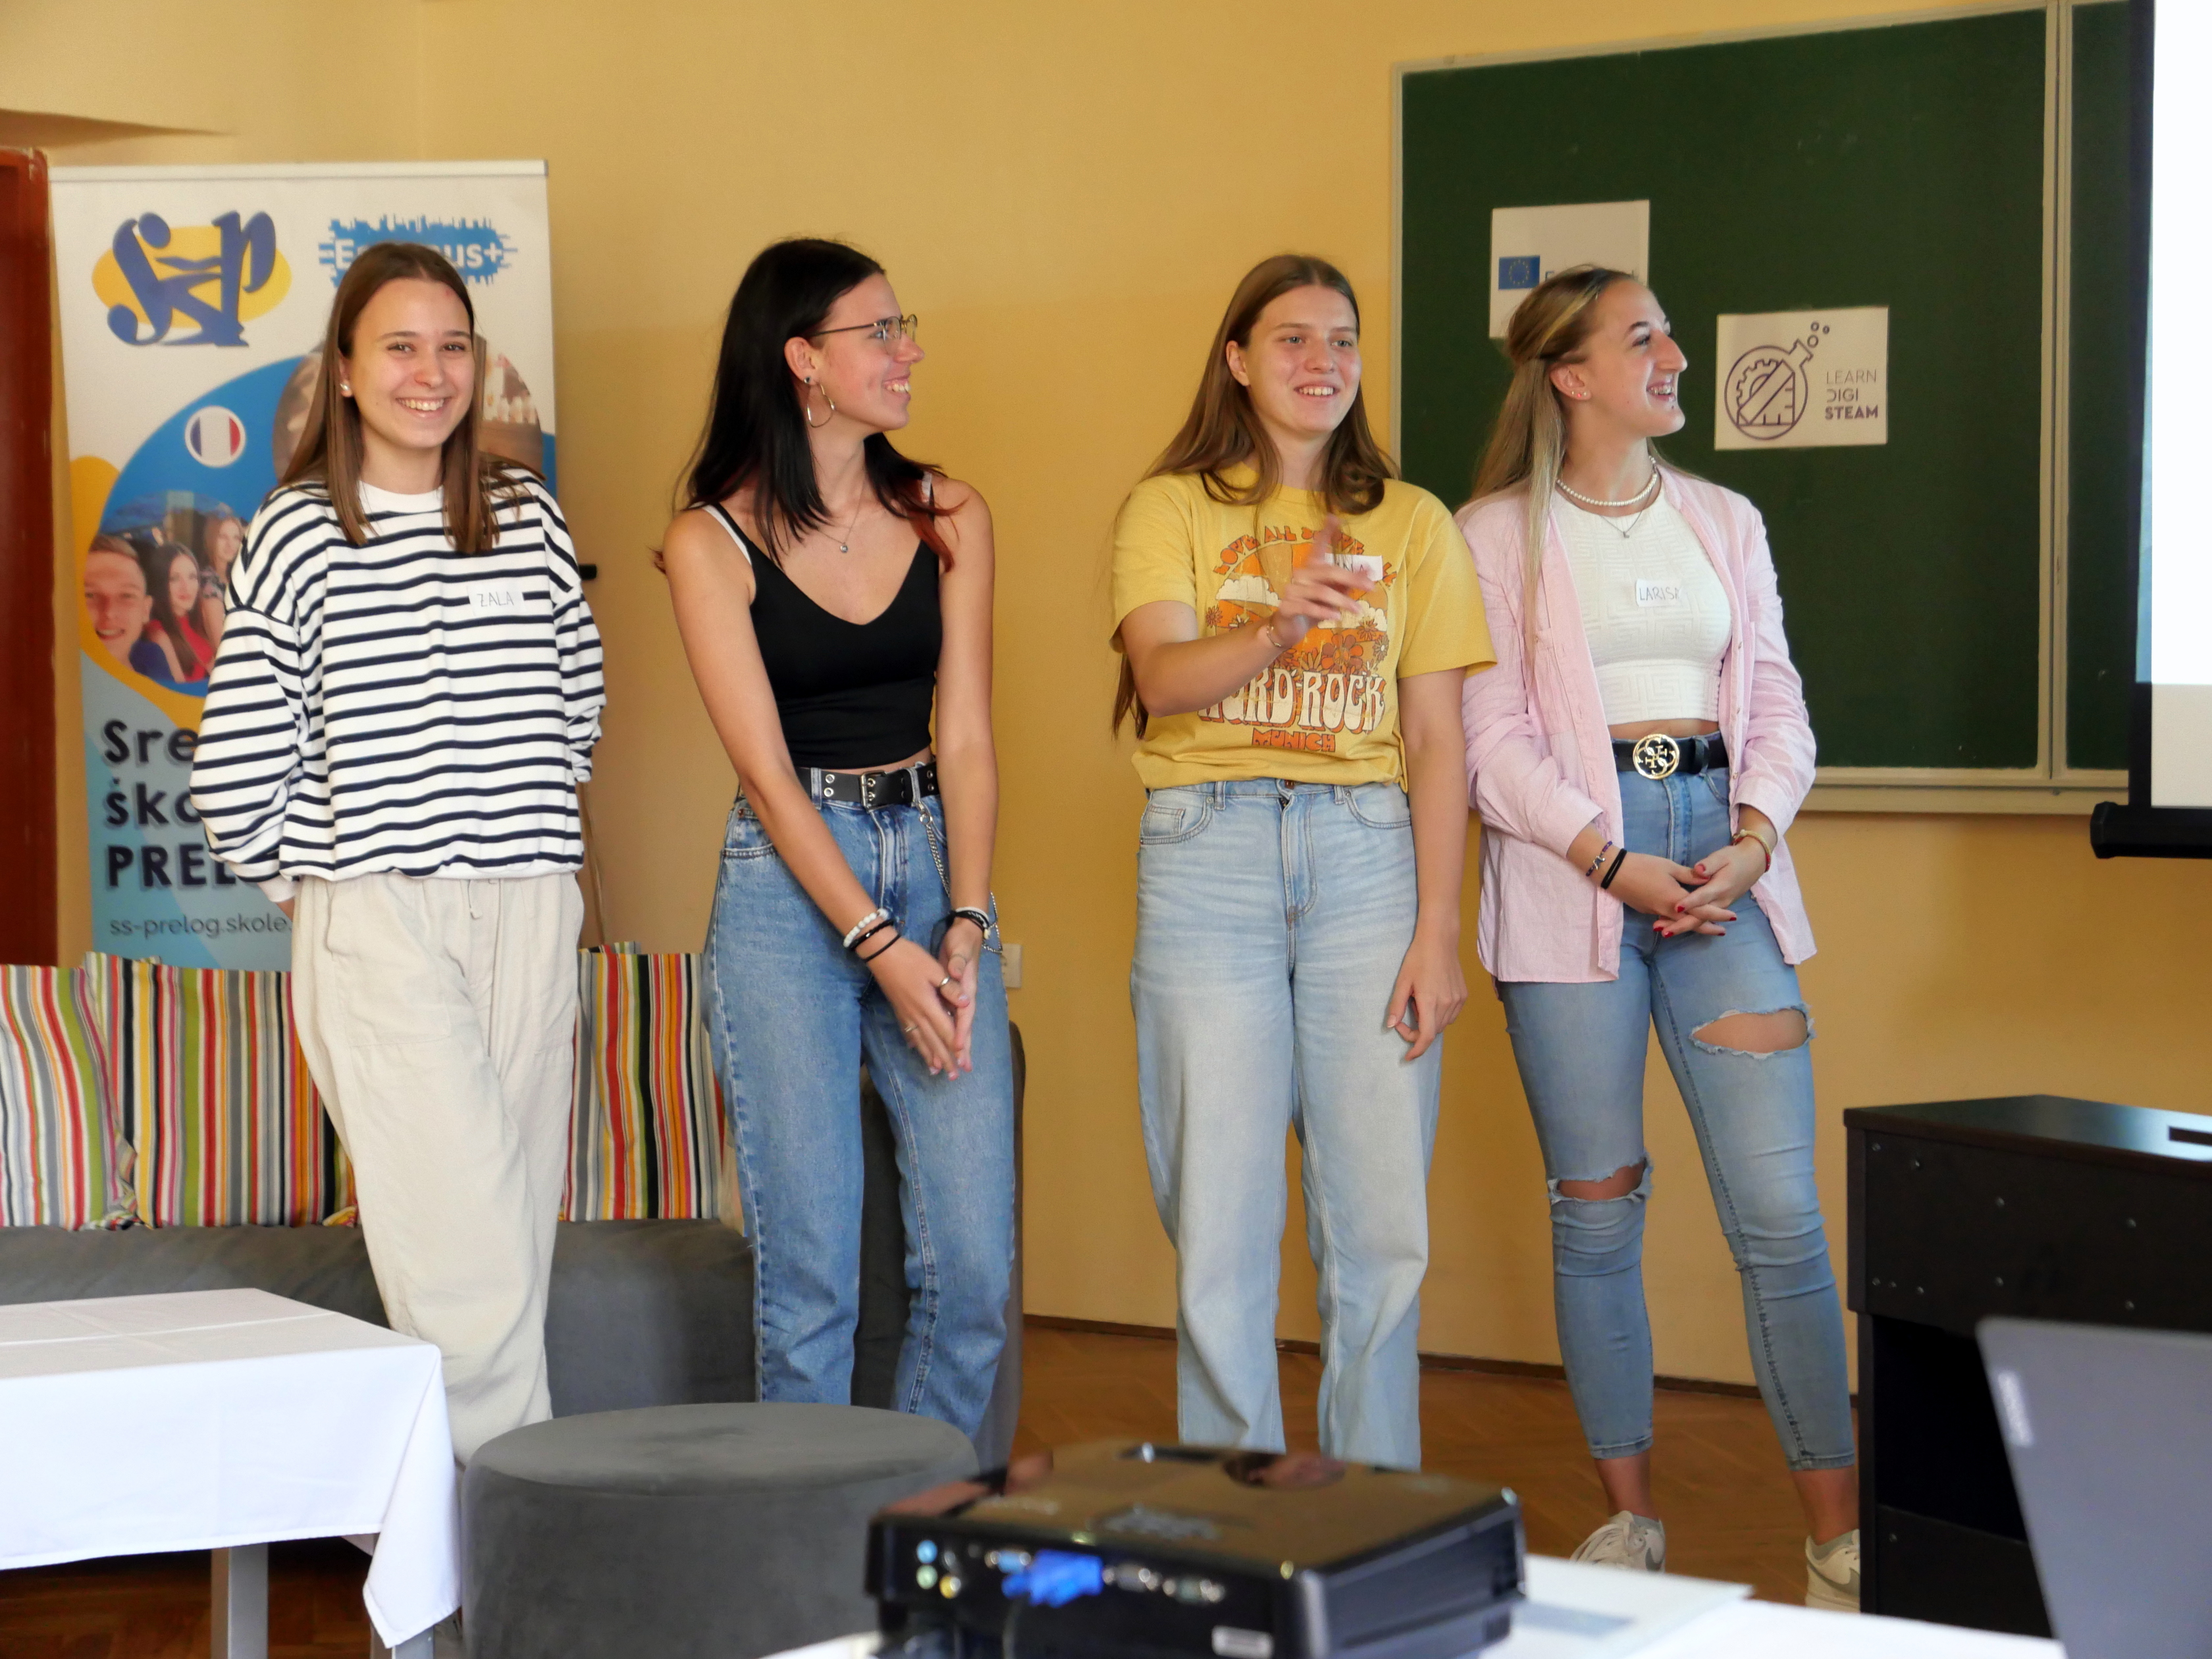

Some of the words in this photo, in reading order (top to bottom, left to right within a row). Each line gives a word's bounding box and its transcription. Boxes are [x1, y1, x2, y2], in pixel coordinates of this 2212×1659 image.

[336, 238, 502, 269] Eus+
[1826, 368, 1877, 384] LEARN
[1825, 404, 1879, 421] STEAM
[1213, 534, 1261, 576] LOVE
[1264, 525, 1298, 544] ALL
[477, 591, 514, 607] ZALA
[1198, 667, 1297, 727] ARD
[1298, 671, 1386, 735] ROCK
[103, 720, 199, 764] Sre
[1252, 727, 1336, 753] MUNICH
